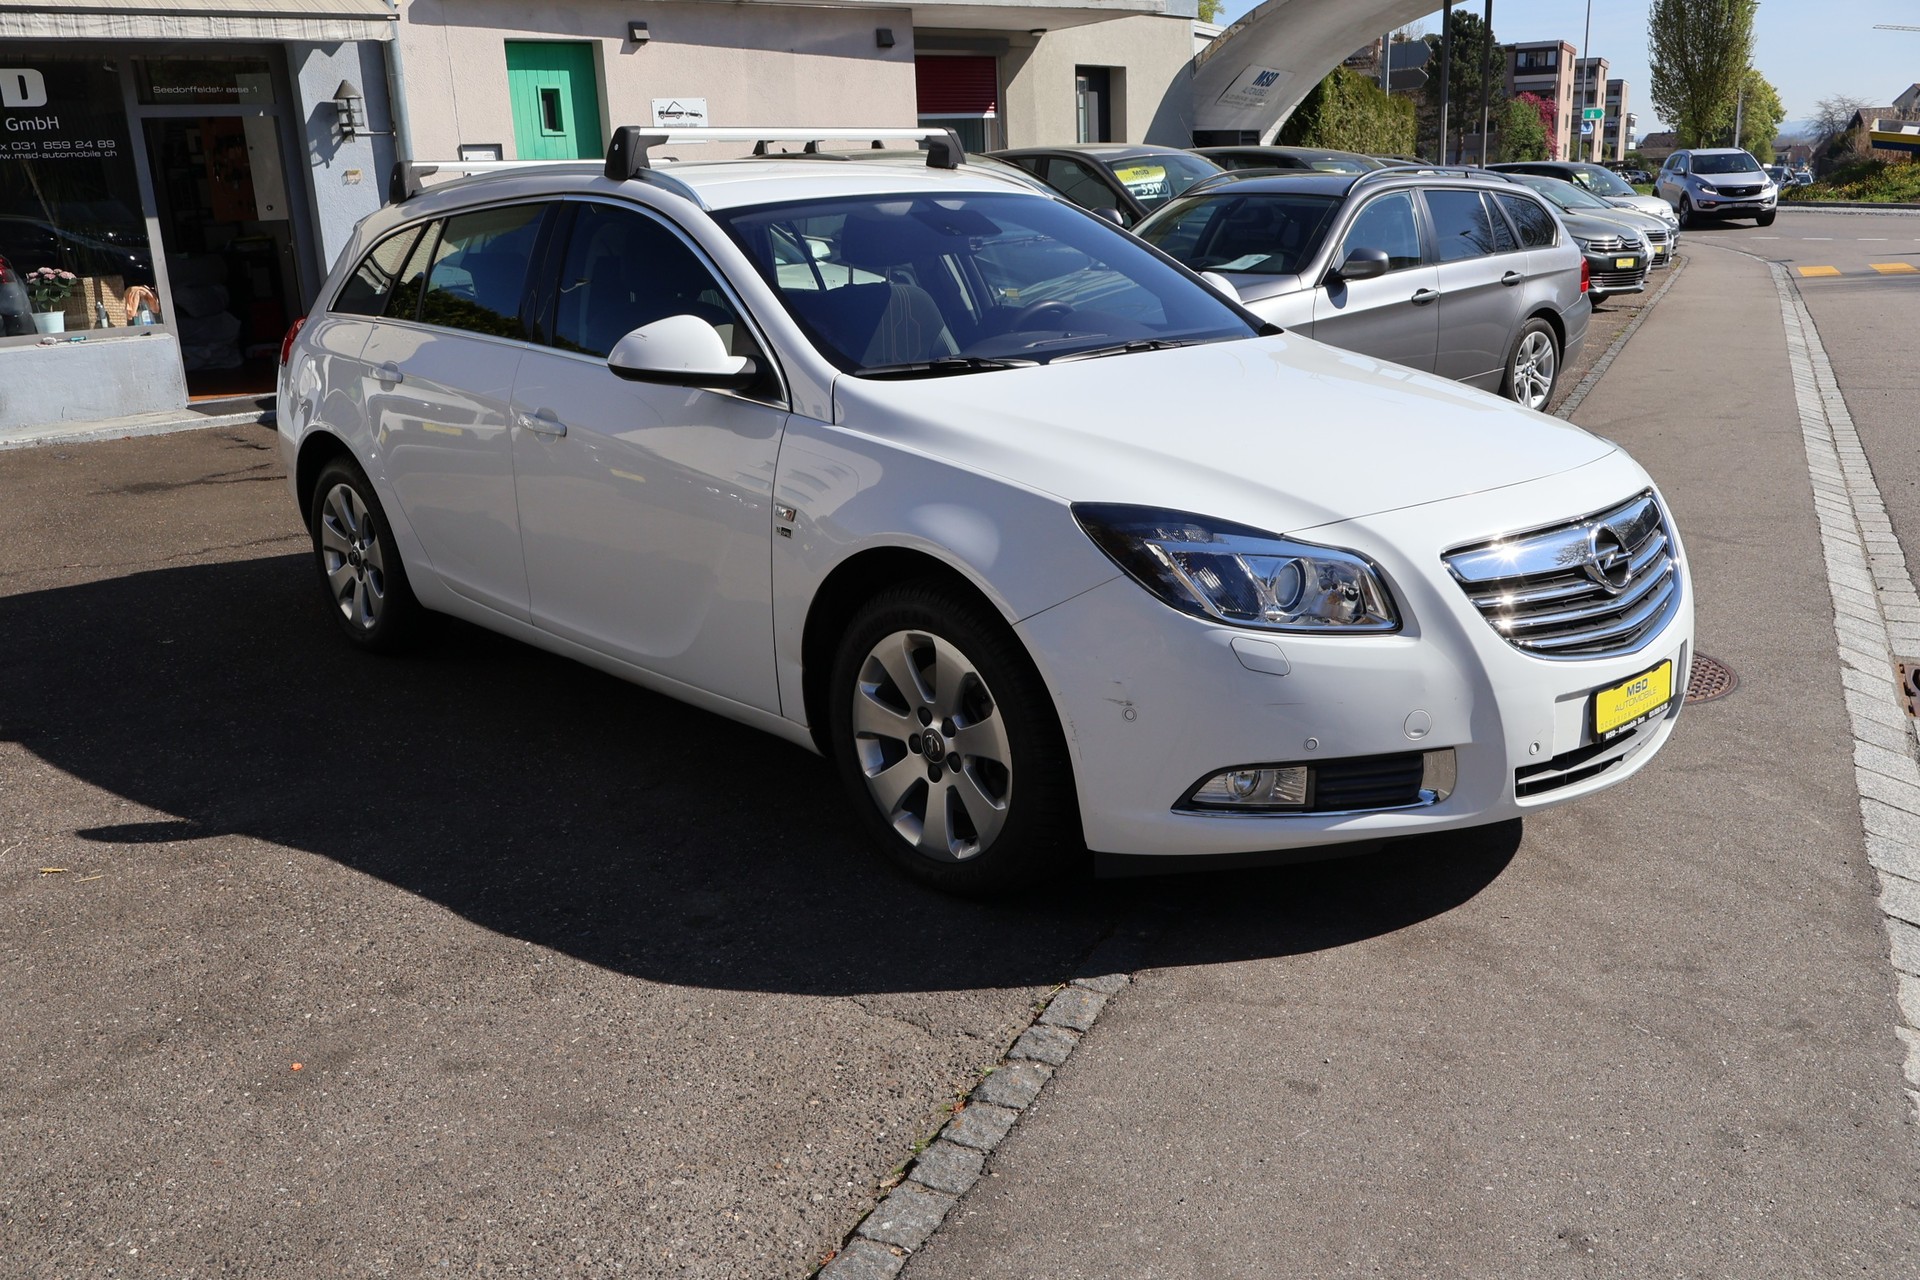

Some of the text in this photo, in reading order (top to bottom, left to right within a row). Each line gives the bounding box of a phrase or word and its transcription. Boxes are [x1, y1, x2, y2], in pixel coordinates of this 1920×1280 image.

[1252, 70, 1280, 87] MSD
[5, 116, 60, 131] GmbH
[11, 141, 37, 151] 031
[43, 141, 71, 150] 859
[75, 140, 94, 149] 24
[97, 140, 116, 148] 89
[1627, 678, 1648, 698] MSD
[1615, 686, 1657, 712] AUTOMOBILE
